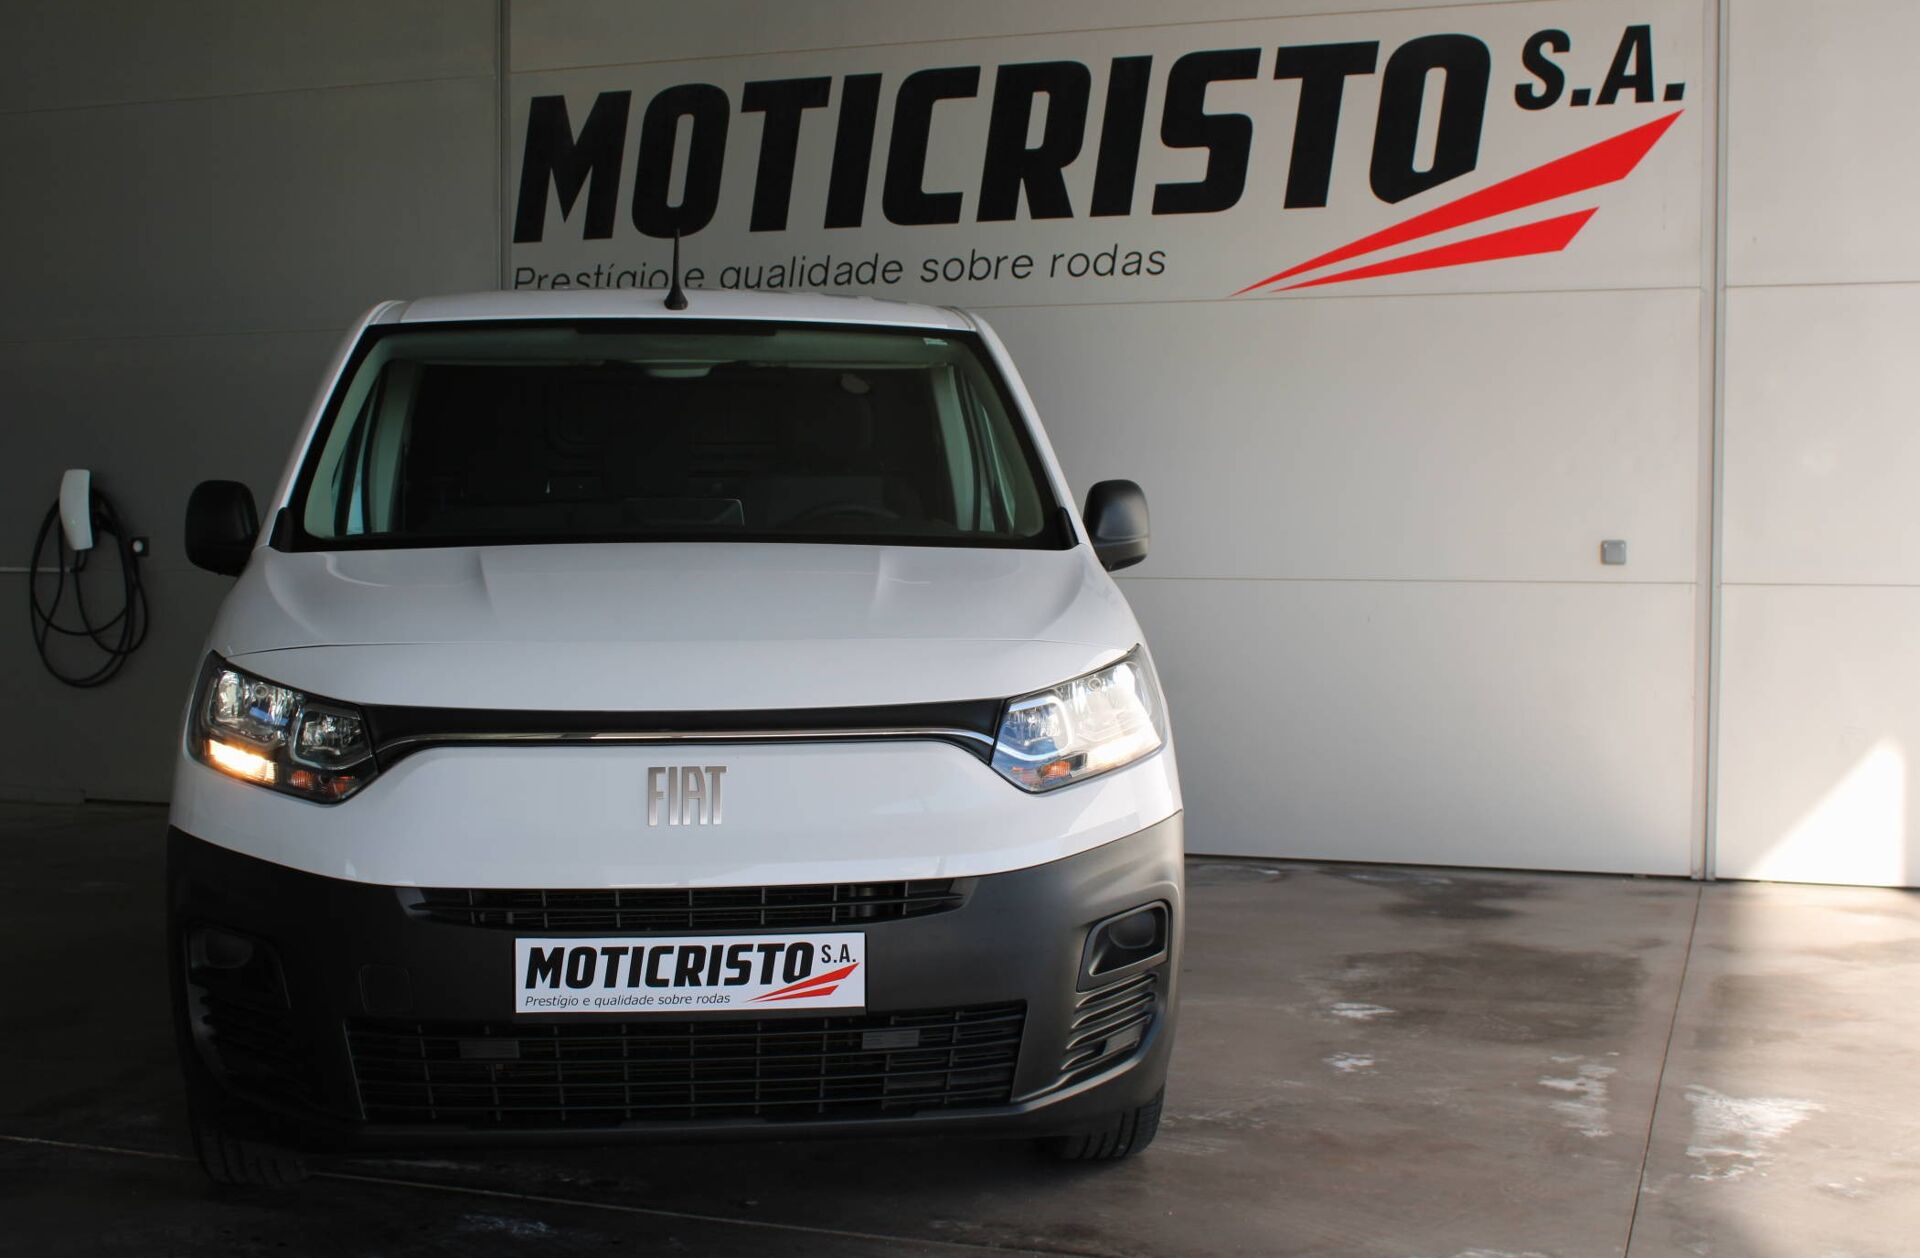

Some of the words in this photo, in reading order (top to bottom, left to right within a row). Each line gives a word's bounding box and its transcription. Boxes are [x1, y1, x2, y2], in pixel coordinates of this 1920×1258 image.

[513, 33, 1491, 243] MOTICRISTO
[1514, 23, 1686, 110] S.A.
[685, 267, 705, 288] e
[720, 253, 903, 289] qualidade
[920, 248, 1034, 283] sobre
[1050, 243, 1166, 278] rodas
[647, 765, 728, 826] FIAT
[525, 941, 814, 989] MOTICRISTO
[821, 944, 857, 964] S.A.
[525, 995, 579, 1008] Prestígio
[582, 998, 591, 1006] e
[594, 995, 654, 1008] qualidade
[657, 995, 693, 1005] sobre
[696, 993, 731, 1004] rodas
